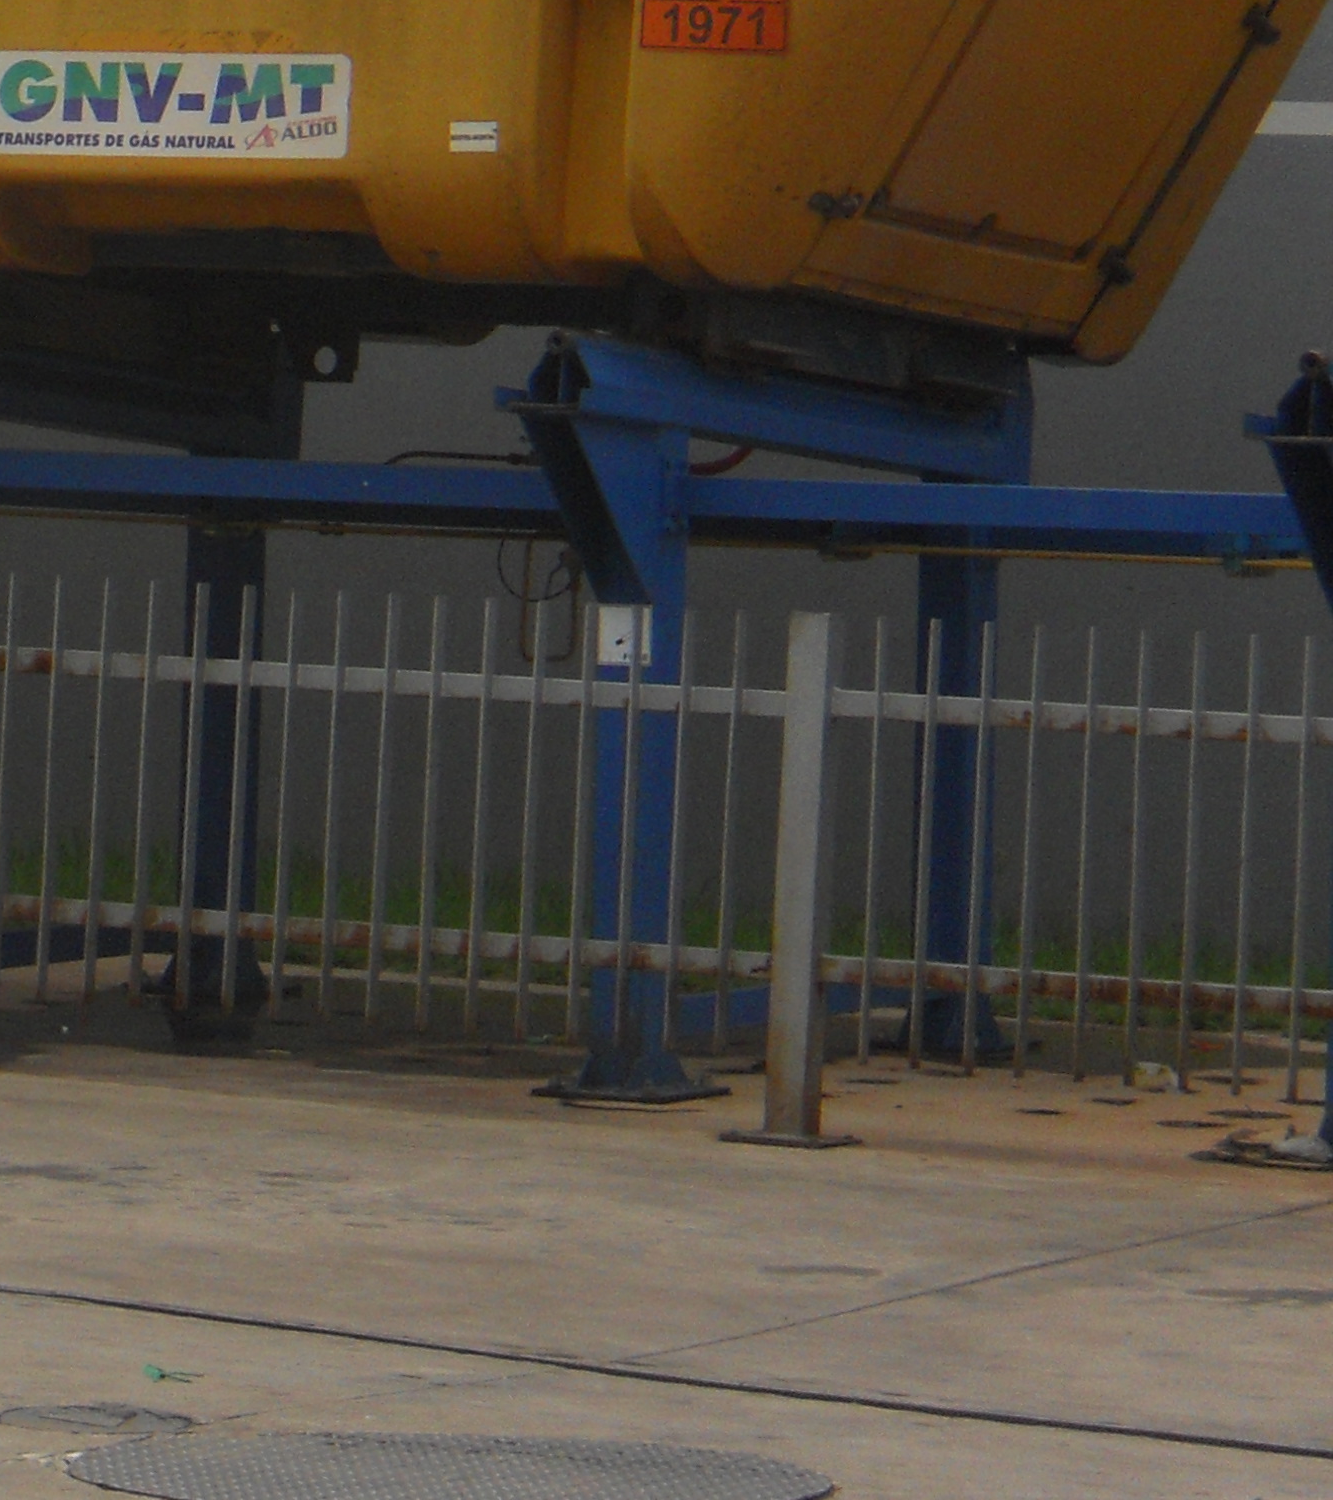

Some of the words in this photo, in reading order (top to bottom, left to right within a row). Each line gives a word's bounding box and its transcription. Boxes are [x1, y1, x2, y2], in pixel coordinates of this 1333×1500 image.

[663, 4, 766, 45] 1971
[104, 133, 126, 148] DE
[165, 133, 236, 150] NATURAL
[281, 121, 338, 142] ALDO
